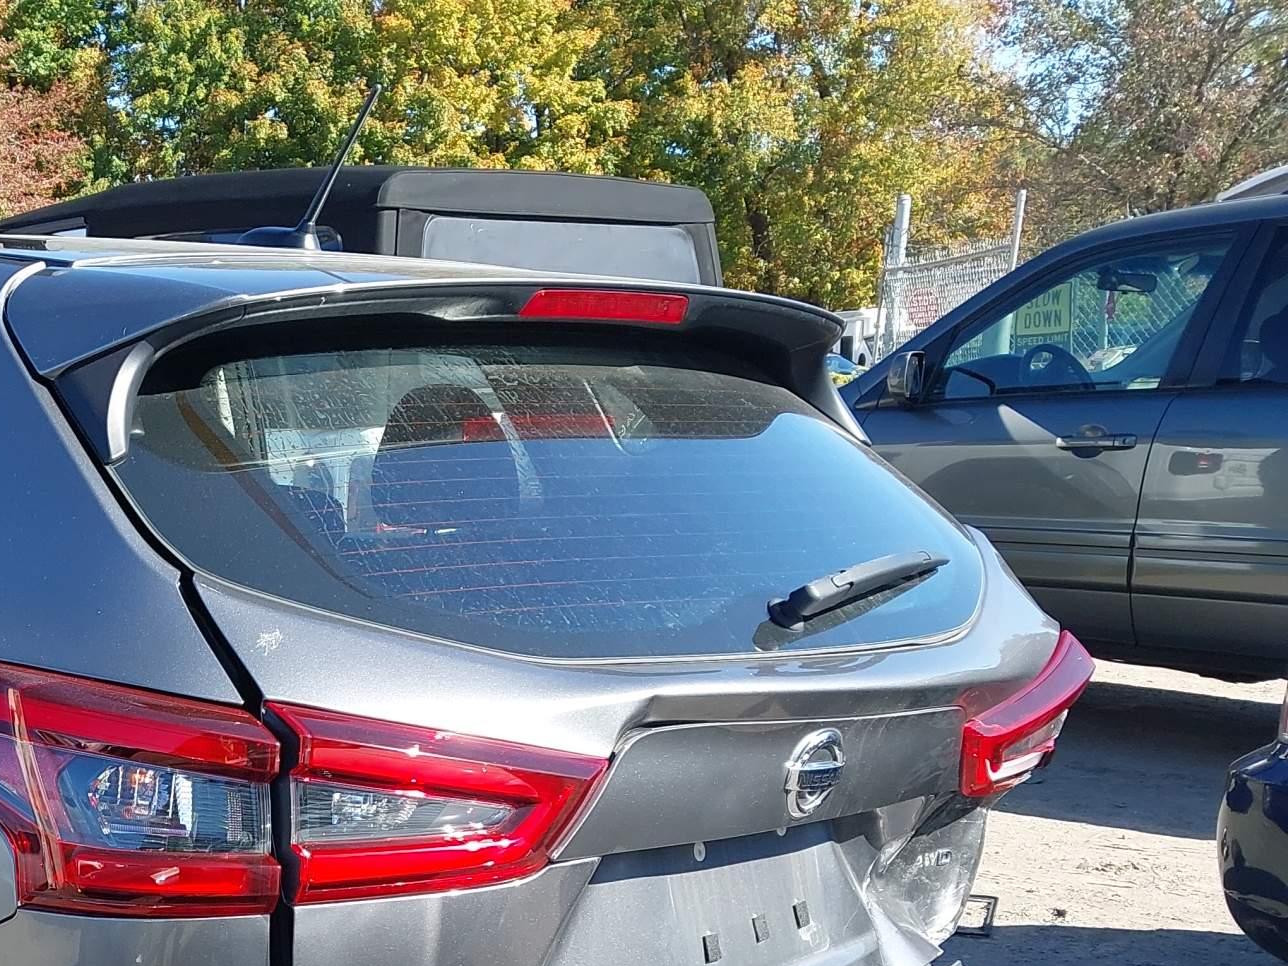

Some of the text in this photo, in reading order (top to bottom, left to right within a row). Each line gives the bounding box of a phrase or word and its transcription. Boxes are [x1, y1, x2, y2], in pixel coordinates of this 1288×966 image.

[1024, 309, 1062, 329] DOWN
[1016, 333, 1068, 346] SPEED LIMIT
